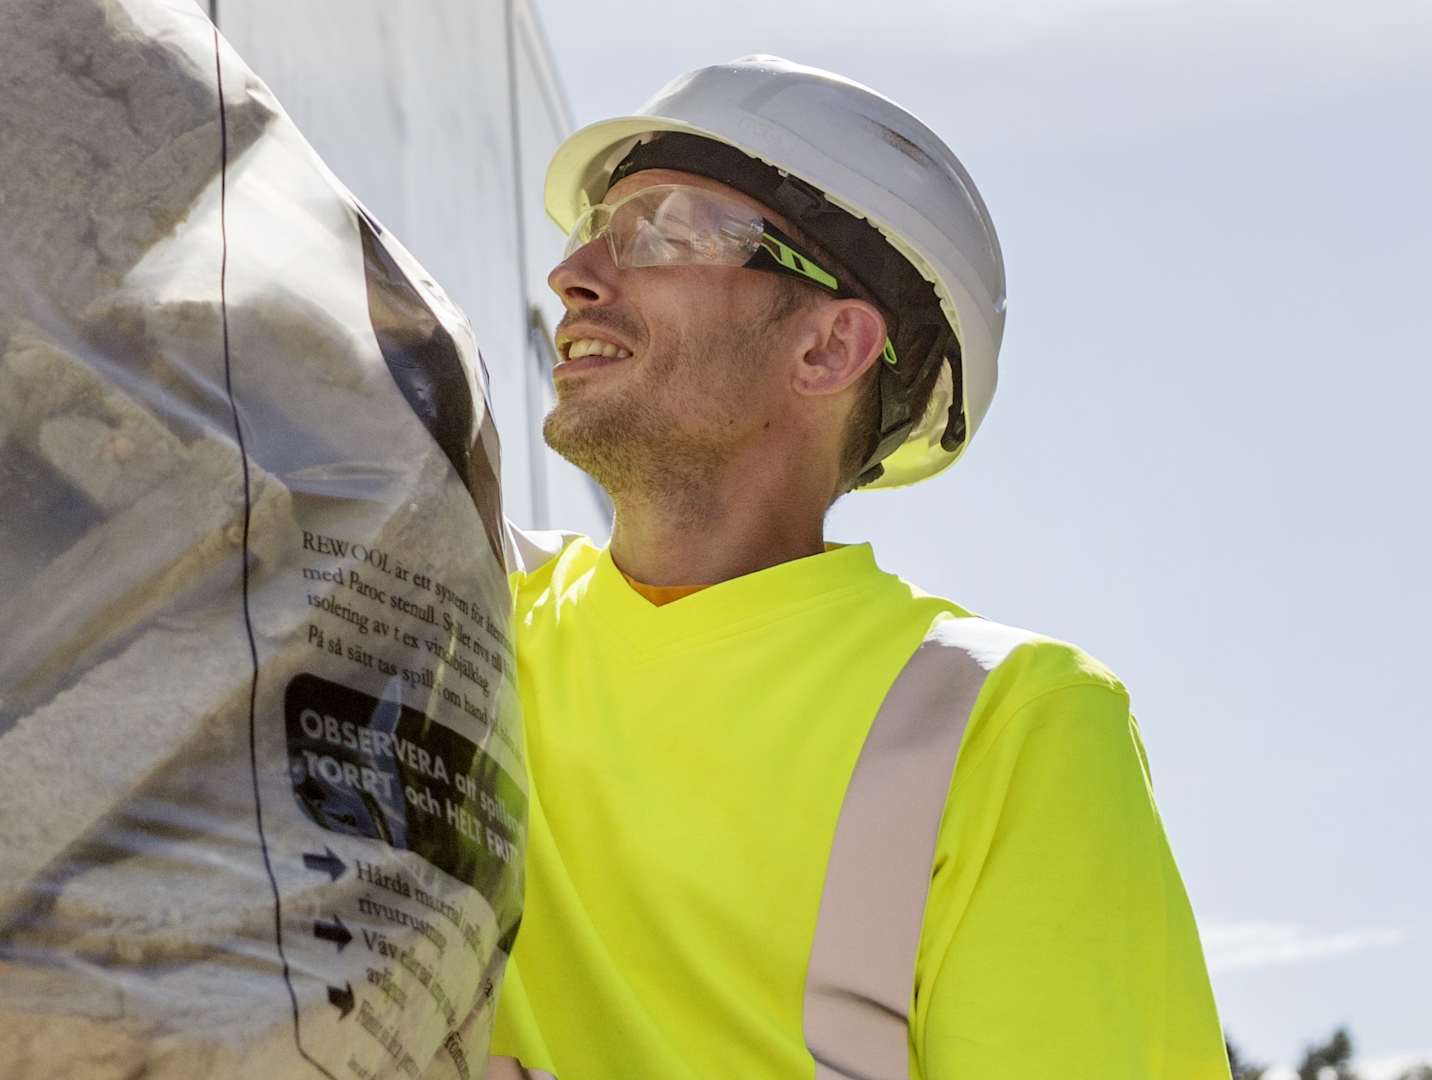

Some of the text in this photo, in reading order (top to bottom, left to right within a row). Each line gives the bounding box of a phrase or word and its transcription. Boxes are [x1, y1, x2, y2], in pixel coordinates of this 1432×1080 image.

[302, 530, 392, 575] REWOOL
[395, 562, 409, 583] är
[413, 571, 432, 593] ett
[302, 566, 344, 586] med
[348, 571, 386, 605] Paroc
[306, 591, 370, 635] isolering
[372, 617, 390, 636] av
[402, 631, 420, 650] ex
[307, 624, 325, 650] På
[327, 634, 344, 659] så
[347, 643, 375, 670] sätt
[377, 656, 399, 679] tas
[442, 686, 463, 711] om
[299, 708, 450, 783] OBSERVERA
[302, 750, 395, 802] TORRT
[404, 784, 442, 819] och
